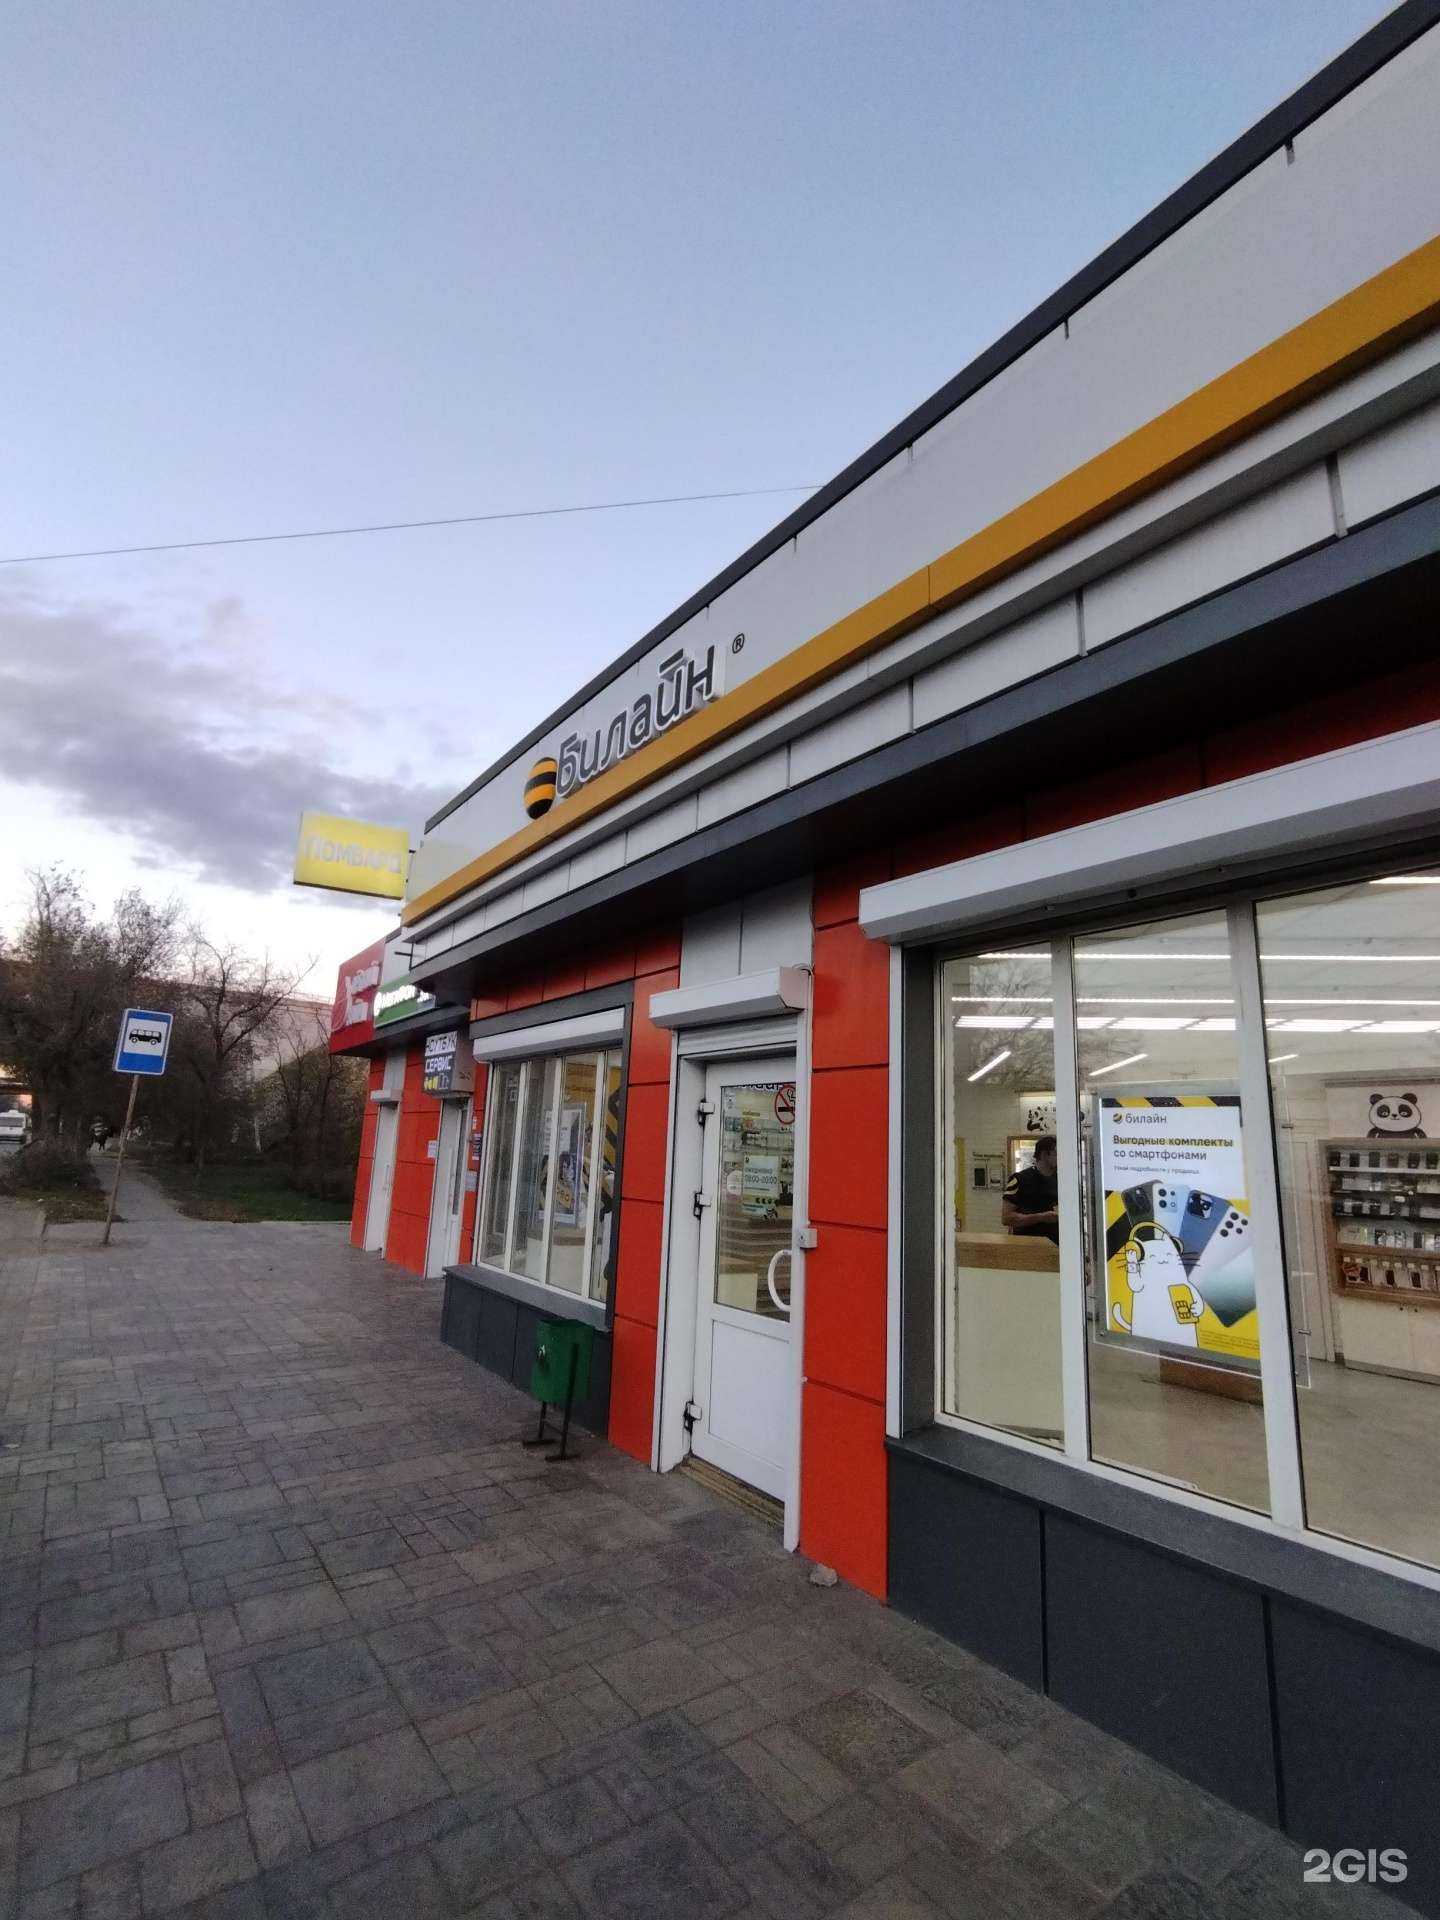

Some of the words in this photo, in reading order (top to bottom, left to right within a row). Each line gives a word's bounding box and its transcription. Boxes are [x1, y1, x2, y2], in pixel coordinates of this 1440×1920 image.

[425, 1055, 453, 1073] СЕРВИС
[1125, 1113, 1167, 1124] билайн
[1113, 1135, 1166, 1146] Выгодные
[1168, 1137, 1233, 1148] комплекты
[1113, 1149, 1126, 1158] со
[1128, 1149, 1207, 1161] смартфонами
